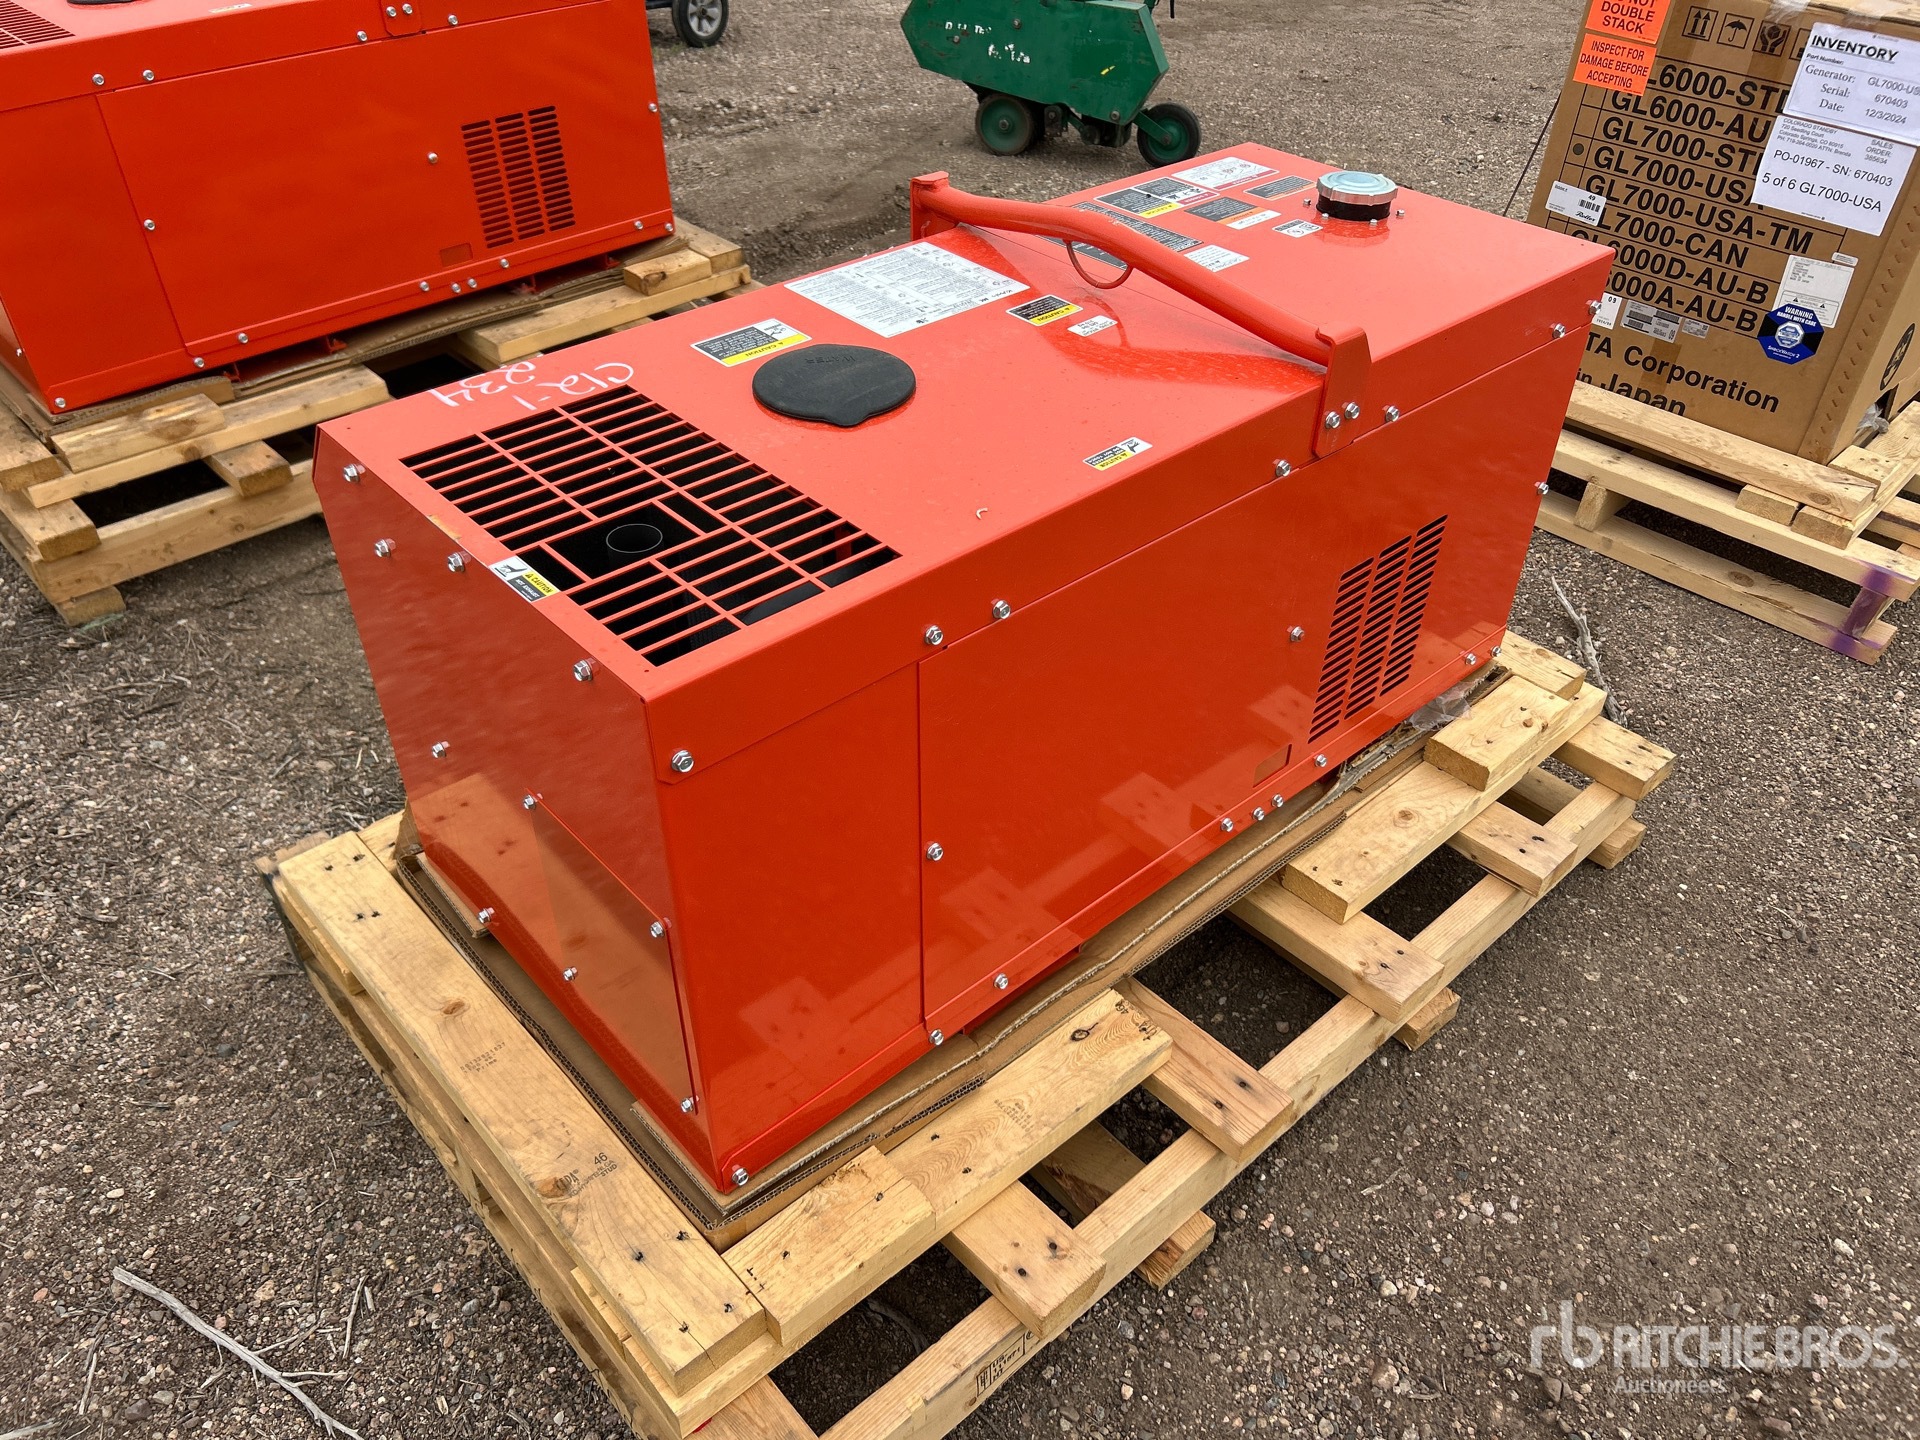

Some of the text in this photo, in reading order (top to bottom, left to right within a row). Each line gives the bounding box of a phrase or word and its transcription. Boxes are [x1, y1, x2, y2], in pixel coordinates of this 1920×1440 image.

[1601, 1, 1655, 22] DOUBLE
[1602, 15, 1645, 34] STACK
[1591, 40, 1645, 61] INSPECT FOR
[1811, 34, 1899, 61] INVENTORY
[1580, 53, 1649, 77] DAMAGE BEFORE
[1586, 70, 1633, 88] ACCEPTING
[1648, 64, 1789, 113] 6000-ST
[1805, 64, 1920, 96] Generator: GL7000-US
[1820, 83, 1909, 109] Serial: 670403
[1819, 98, 1907, 125] Date: 12/3/2024
[1779, 129, 1799, 139] Colorado
[1783, 118, 1838, 135] COLORADO STANDBY
[1870, 139, 1894, 149] SALES
[1774, 150, 1825, 169] PO-01967
[1832, 164, 1851, 177] SN:
[1854, 169, 1893, 187] 670403
[1762, 172, 1882, 212] 5 of 6 GL7000-USA
[1586, 175, 1814, 254] GL7000-USA-TM
[1597, 207, 1750, 269] L7000-CAN
[1607, 296, 1617, 304] 09
[1037, 309, 1065, 322] CAUTION
[1776, 311, 1817, 327] HANDLE WITH CARE
[1785, 306, 1814, 320] WARNING
[744, 343, 780, 358] CAUTION
[1624, 345, 1780, 413] Corporation
[1601, 374, 1687, 416] Japan
[531, 574, 553, 594] CAUTION
[594, 1152, 608, 1165] 46
[600, 1163, 618, 1177] STUD
